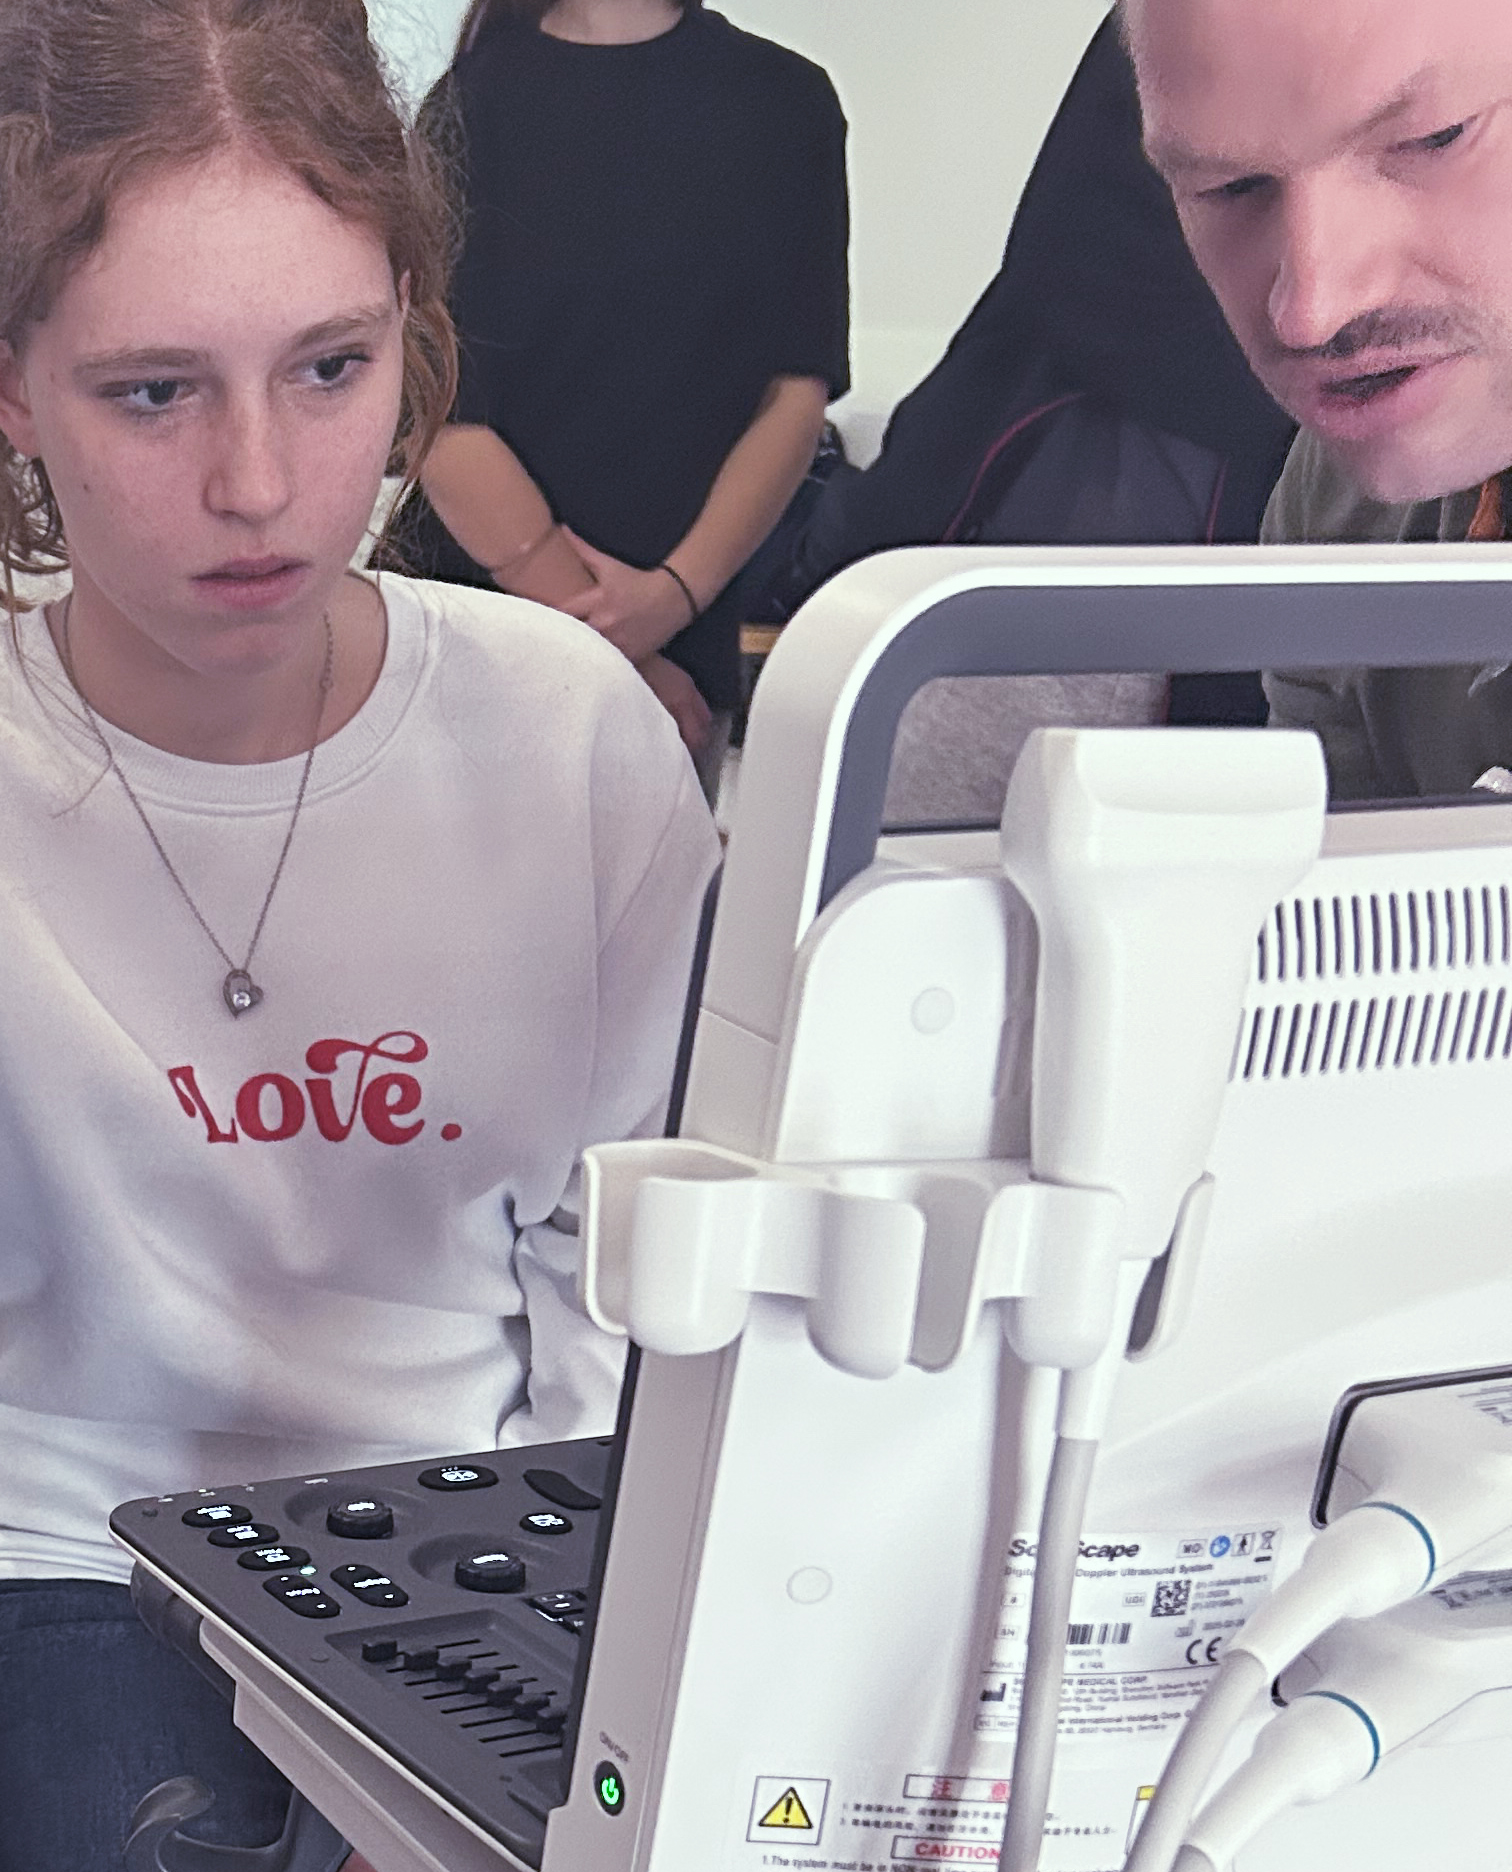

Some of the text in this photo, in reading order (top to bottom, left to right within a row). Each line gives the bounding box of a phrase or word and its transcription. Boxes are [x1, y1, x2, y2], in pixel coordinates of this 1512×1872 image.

[167, 1030, 463, 1146] Love.
[1008, 1538, 1139, 1561] Socape
[1075, 1568, 1117, 1578] Doppler
[1120, 1566, 1175, 1577] Ultrasound
[1078, 1678, 1117, 1686] MEDICAL
[915, 1842, 1001, 1859] CAUTION
